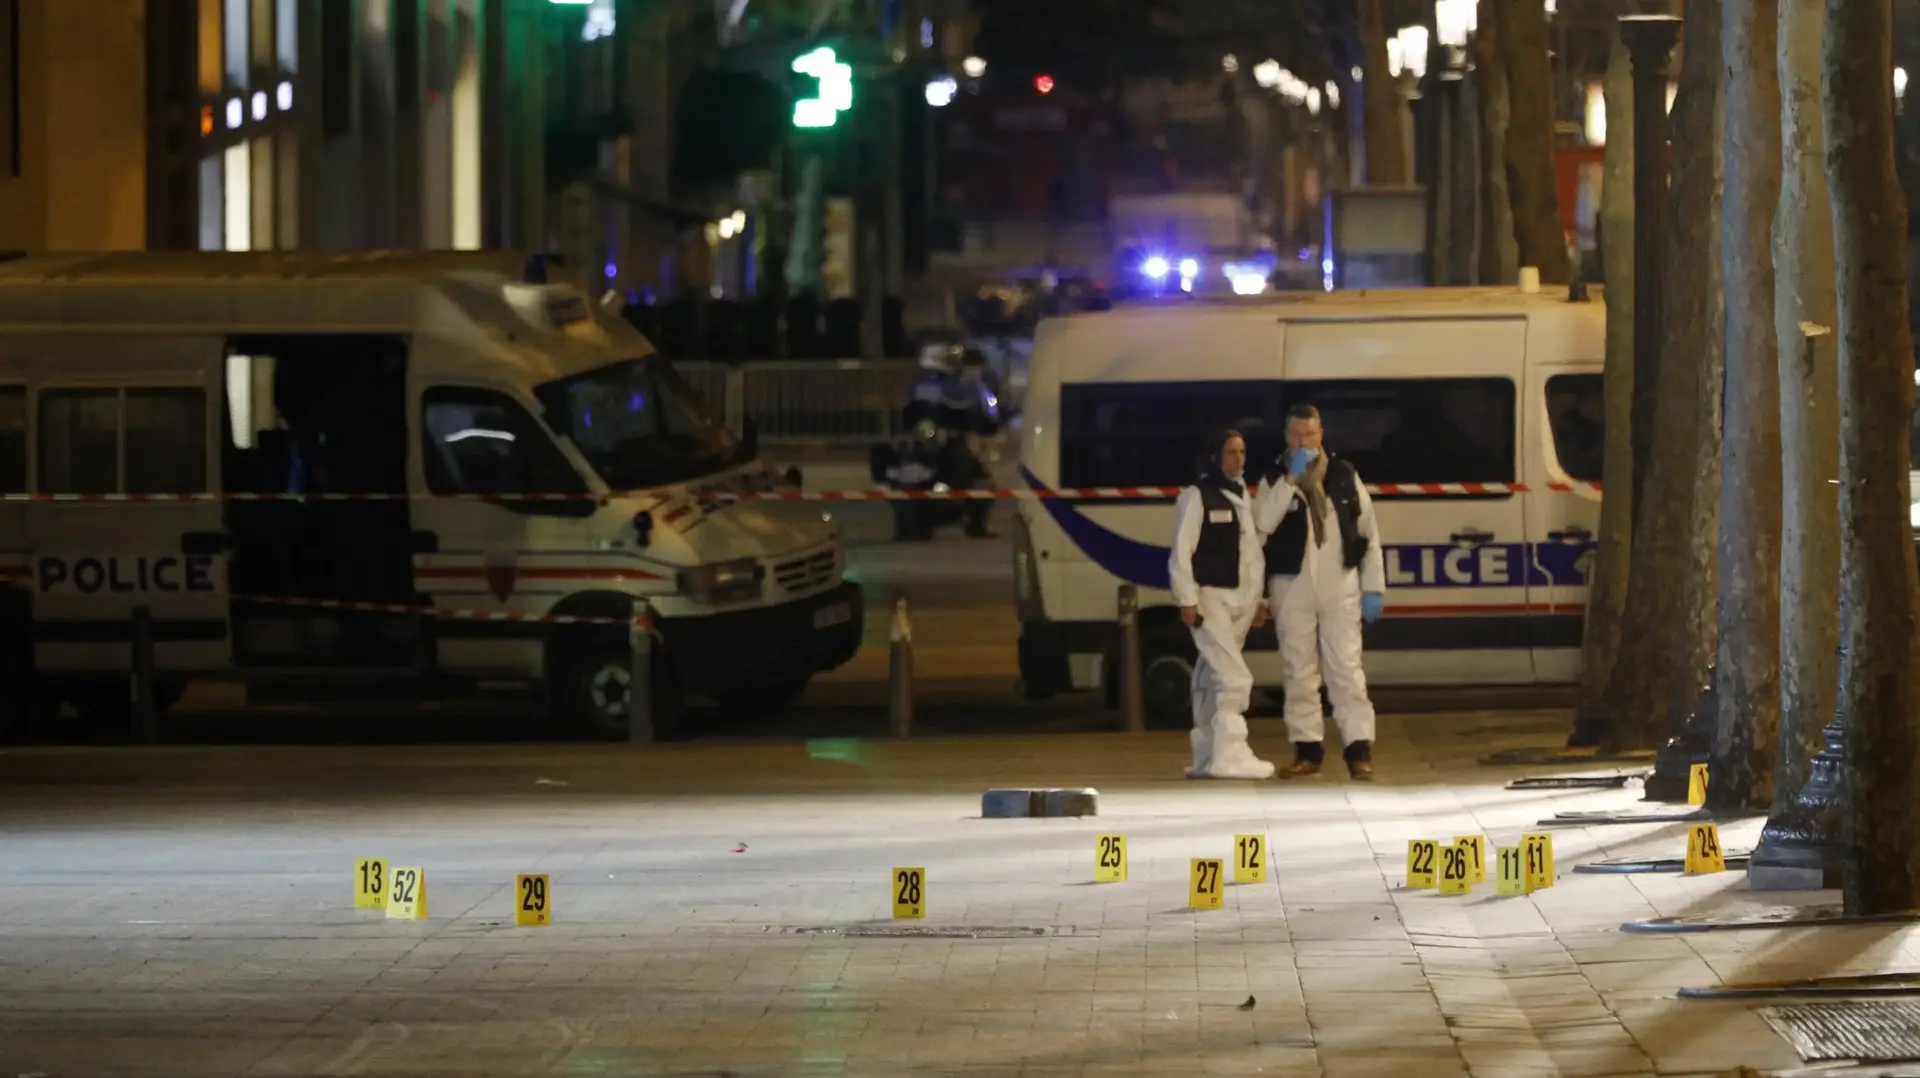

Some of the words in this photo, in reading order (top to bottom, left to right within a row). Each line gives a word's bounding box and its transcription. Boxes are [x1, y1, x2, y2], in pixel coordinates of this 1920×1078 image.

[40, 556, 214, 593] POLICE
[1385, 547, 1510, 584] LICE
[1100, 836, 1121, 868] 25
[1239, 837, 1259, 868] 12
[1412, 842, 1434, 873] 22
[1460, 838, 1479, 868] 1
[1697, 827, 1718, 858] 24
[360, 861, 382, 894] 13
[1196, 861, 1219, 894] 27
[1444, 848, 1465, 880] 26
[1502, 848, 1519, 880] 11
[393, 870, 416, 903] 52
[522, 877, 545, 911] 29
[897, 871, 920, 904] 28
